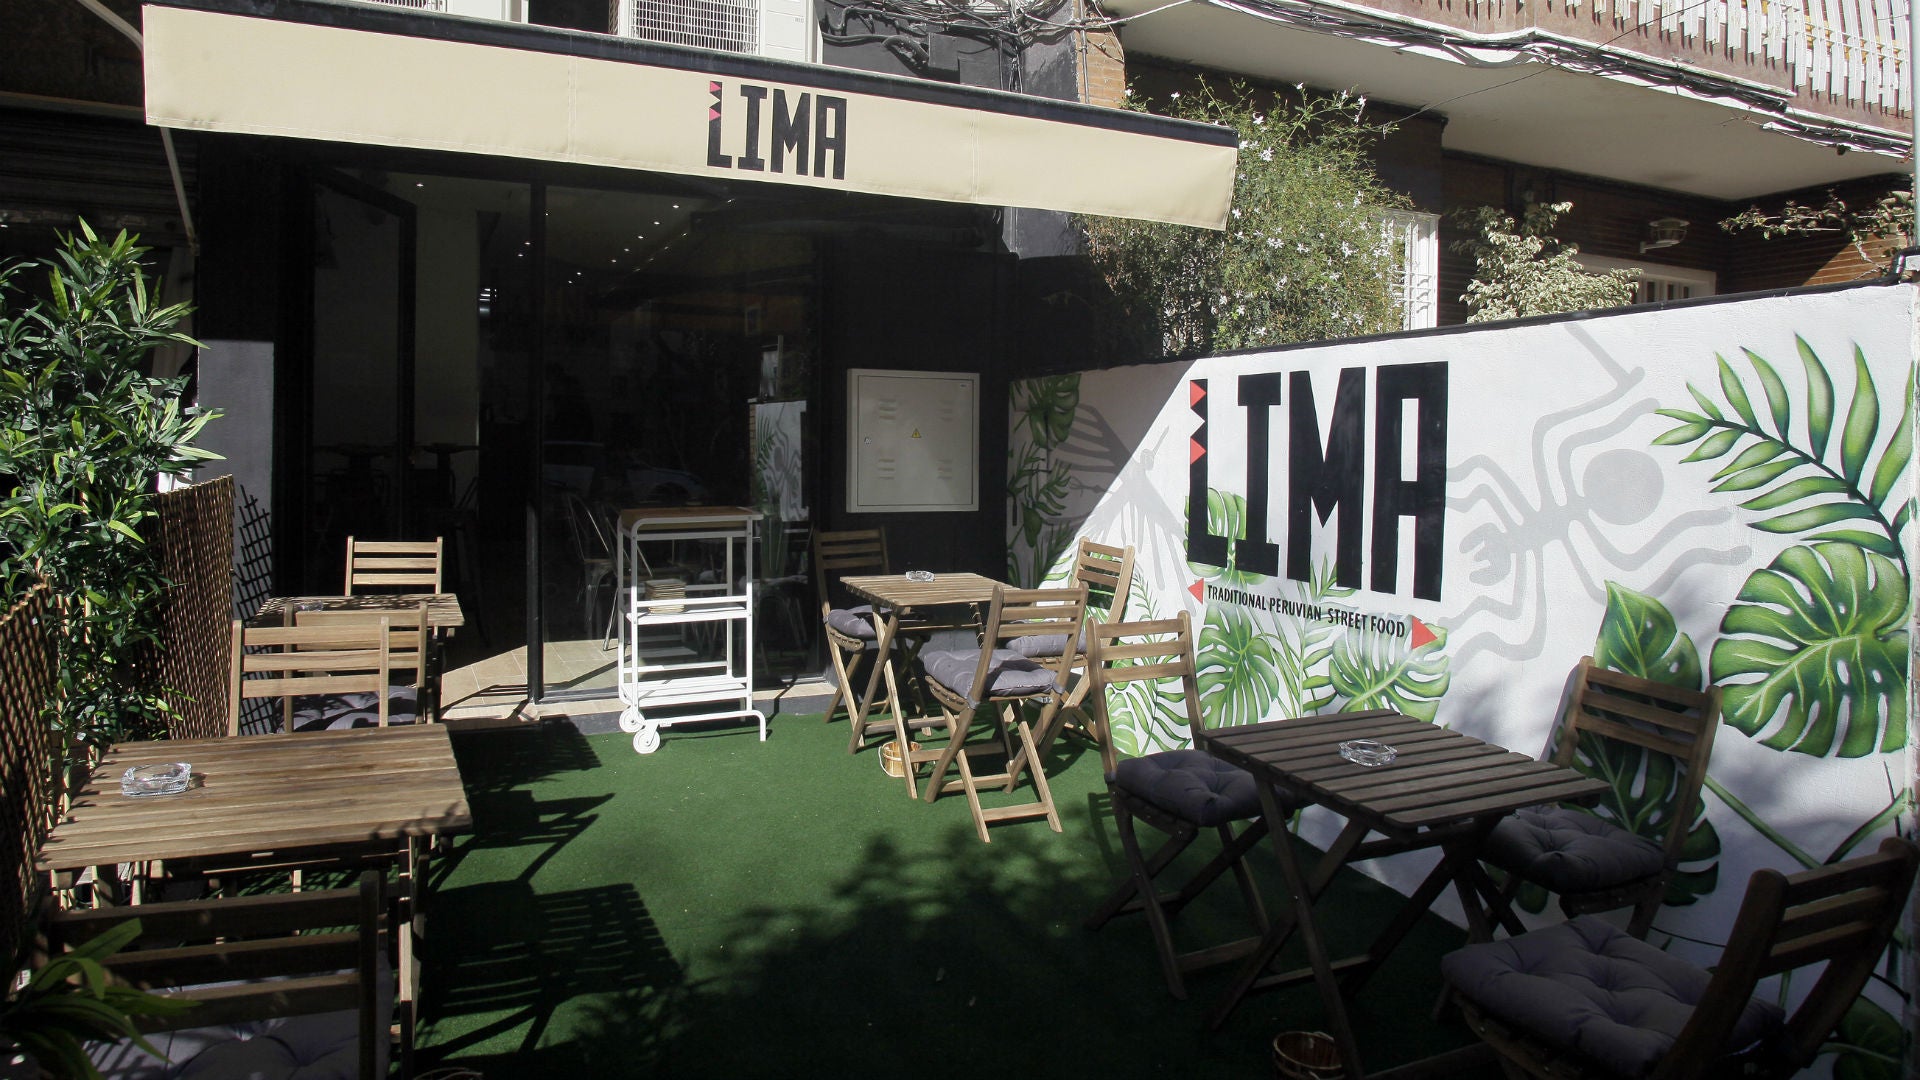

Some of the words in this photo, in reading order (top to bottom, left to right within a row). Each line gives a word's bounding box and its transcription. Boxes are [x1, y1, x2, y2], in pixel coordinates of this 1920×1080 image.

[707, 80, 847, 180] LIMA
[1187, 361, 1448, 602] LIMA
[1207, 584, 1267, 611] TRADITIONAL
[1269, 597, 1322, 621] PERUVIAN
[1327, 607, 1368, 631] STREET
[1370, 615, 1405, 638] FOOD
